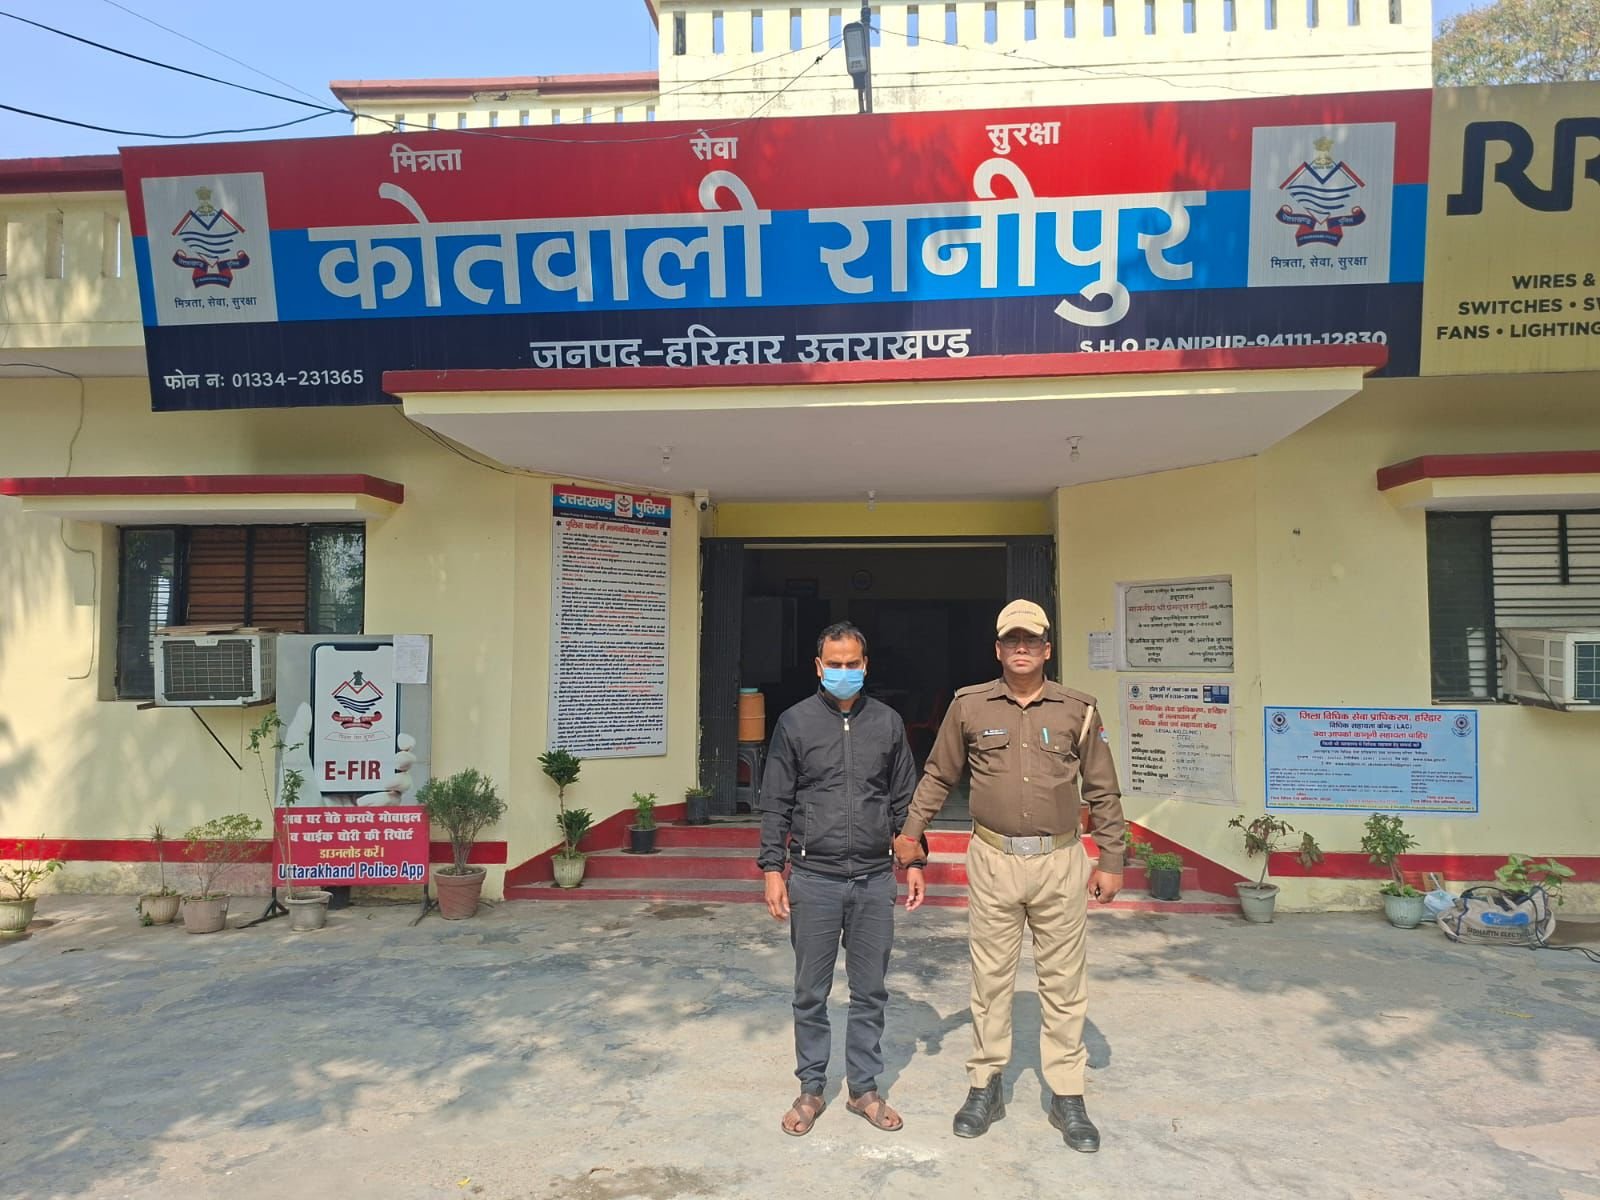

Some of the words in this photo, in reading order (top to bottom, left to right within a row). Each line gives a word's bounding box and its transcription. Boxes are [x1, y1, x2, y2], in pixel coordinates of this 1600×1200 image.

[390, 144, 462, 174] मित्रता
[690, 130, 738, 162] सेवा
[987, 121, 1061, 155] सुरक्षा
[308, 170, 772, 309] कोतवाली
[808, 157, 1207, 327] रानीपुर
[1270, 256, 1306, 270] मित्रता,
[1309, 255, 1334, 268] सेवा,
[1338, 255, 1368, 271] सुरक्षा
[1512, 273, 1577, 289] WIRES
[1583, 272, 1596, 287] &
[174, 296, 205, 309] मित्रता,
[207, 295, 229, 308] सेवा,
[231, 296, 257, 310] सुरक्षा
[1458, 298, 1563, 315] SWITCHES
[1437, 325, 1490, 340] FANS
[1510, 321, 1600, 338] LIGHTING
[795, 328, 972, 363] उत्तराखण्ड
[163, 369, 200, 390] फोन
[232, 369, 364, 388] 01334-231365
[559, 492, 614, 510] उत्तराखण्ड
[635, 498, 666, 518] पुलिस
[1299, 711, 1321, 720] जिला
[1323, 711, 1349, 720] विधिक
[1352, 711, 1368, 721] सेवा
[1414, 712, 1442, 722] हरिद्वार
[325, 760, 381, 780] E-FIR
[306, 813, 321, 824] घर
[324, 811, 342, 824] बैठे
[290, 832, 299, 842] व
[338, 830, 361, 842] चोरी
[364, 829, 381, 841] की
[383, 827, 414, 841] रिपोर्ट
[319, 845, 361, 859] डाउनलोड
[278, 862, 356, 880] Uttarakhand
[359, 861, 398, 878] Police
[400, 861, 424, 880] App
